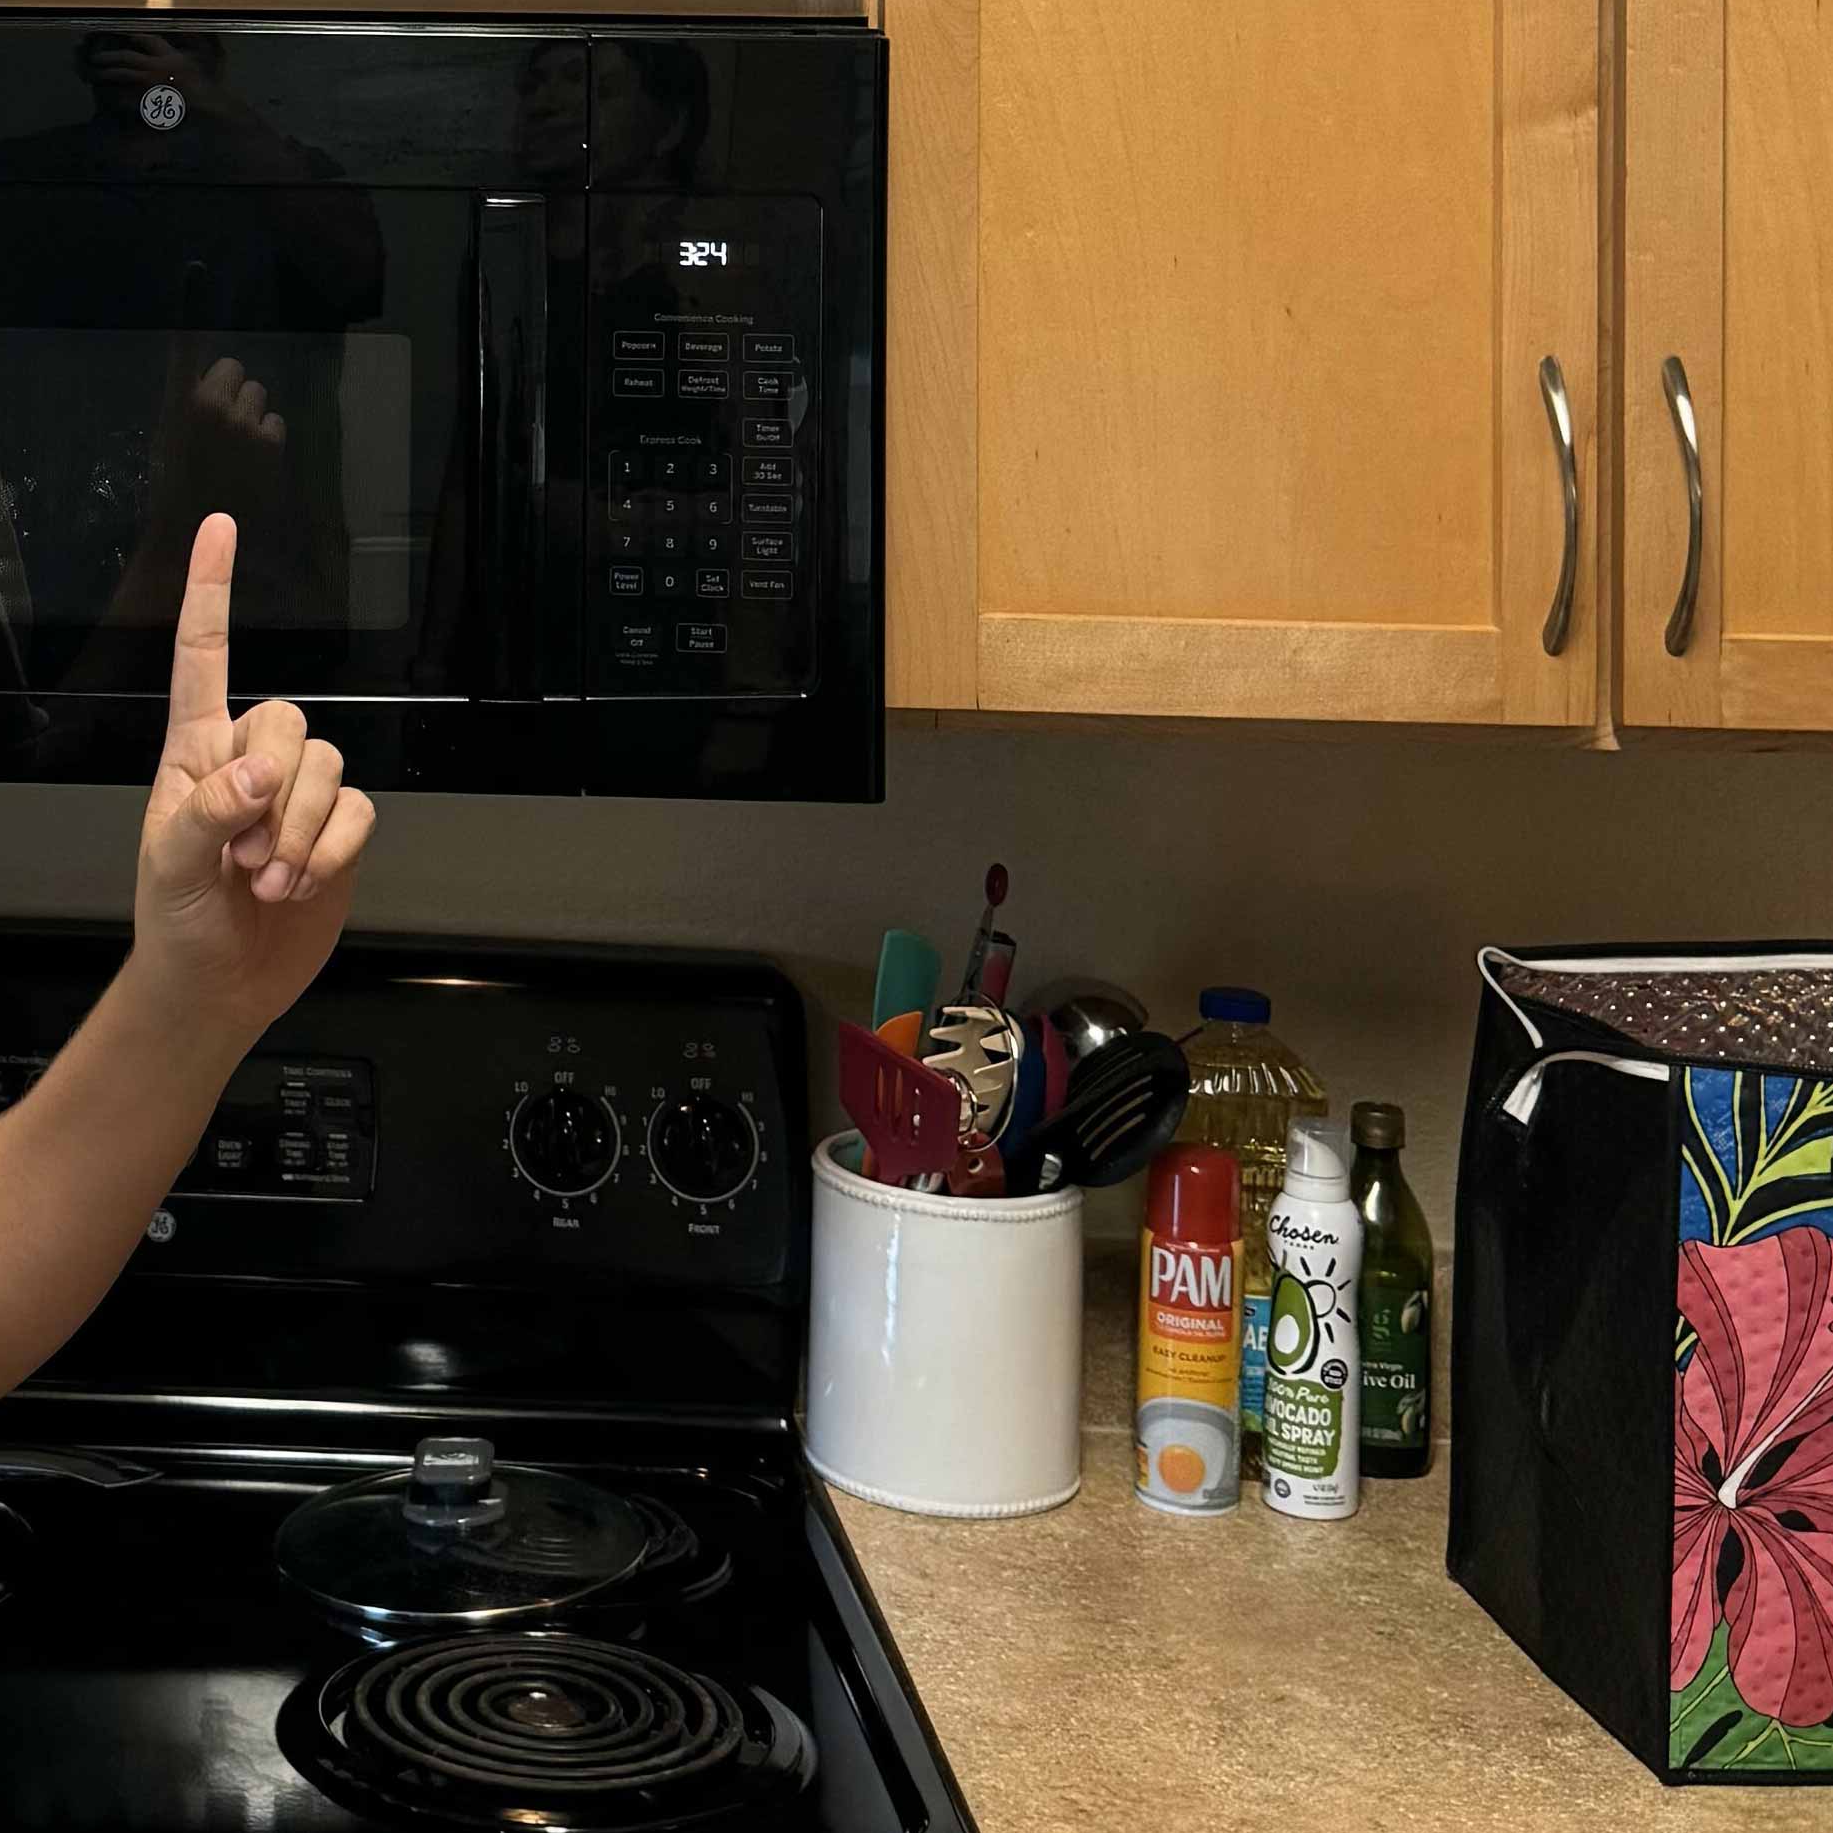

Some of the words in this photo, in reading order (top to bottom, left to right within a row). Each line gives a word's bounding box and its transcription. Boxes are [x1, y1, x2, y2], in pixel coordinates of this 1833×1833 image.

[623, 462, 631, 473] 1
[665, 462, 675, 474] 2
[708, 463, 718, 475] 3
[665, 500, 675, 512] 5
[708, 501, 718, 513] 6
[623, 535, 631, 547] 7
[665, 537, 675, 549] 8
[708, 538, 718, 551] 9
[554, 1071, 575, 1084] OFF
[690, 1077, 711, 1090] OFF
[1269, 1215, 1339, 1244] Chosen
[1151, 1246, 1231, 1309] PAM
[1156, 1312, 1224, 1332] ORIGINAL
[1390, 1373, 1416, 1389] Oil
[1281, 1423, 1335, 1447] SPRAY
